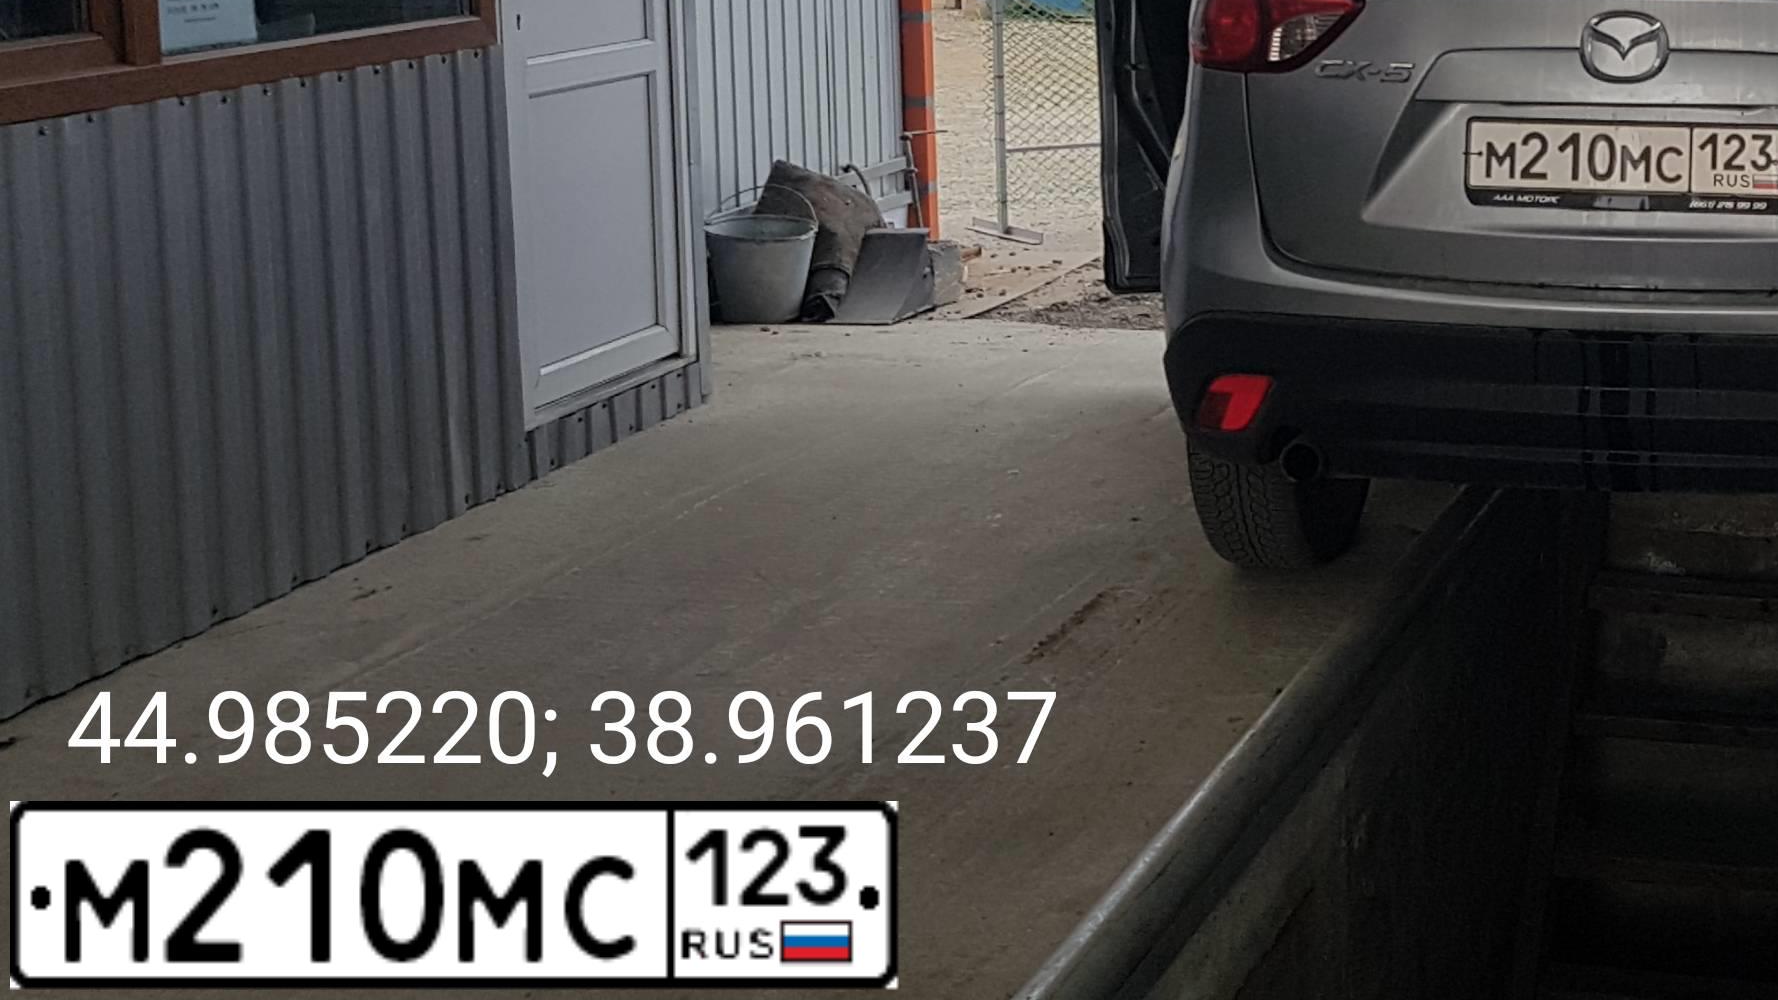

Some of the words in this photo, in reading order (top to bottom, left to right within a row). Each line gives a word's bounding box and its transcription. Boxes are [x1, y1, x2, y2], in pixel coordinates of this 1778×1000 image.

[1315, 59, 1415, 83] CX-5
[1698, 133, 1773, 172] 123
[1713, 173, 1750, 188] RUS
